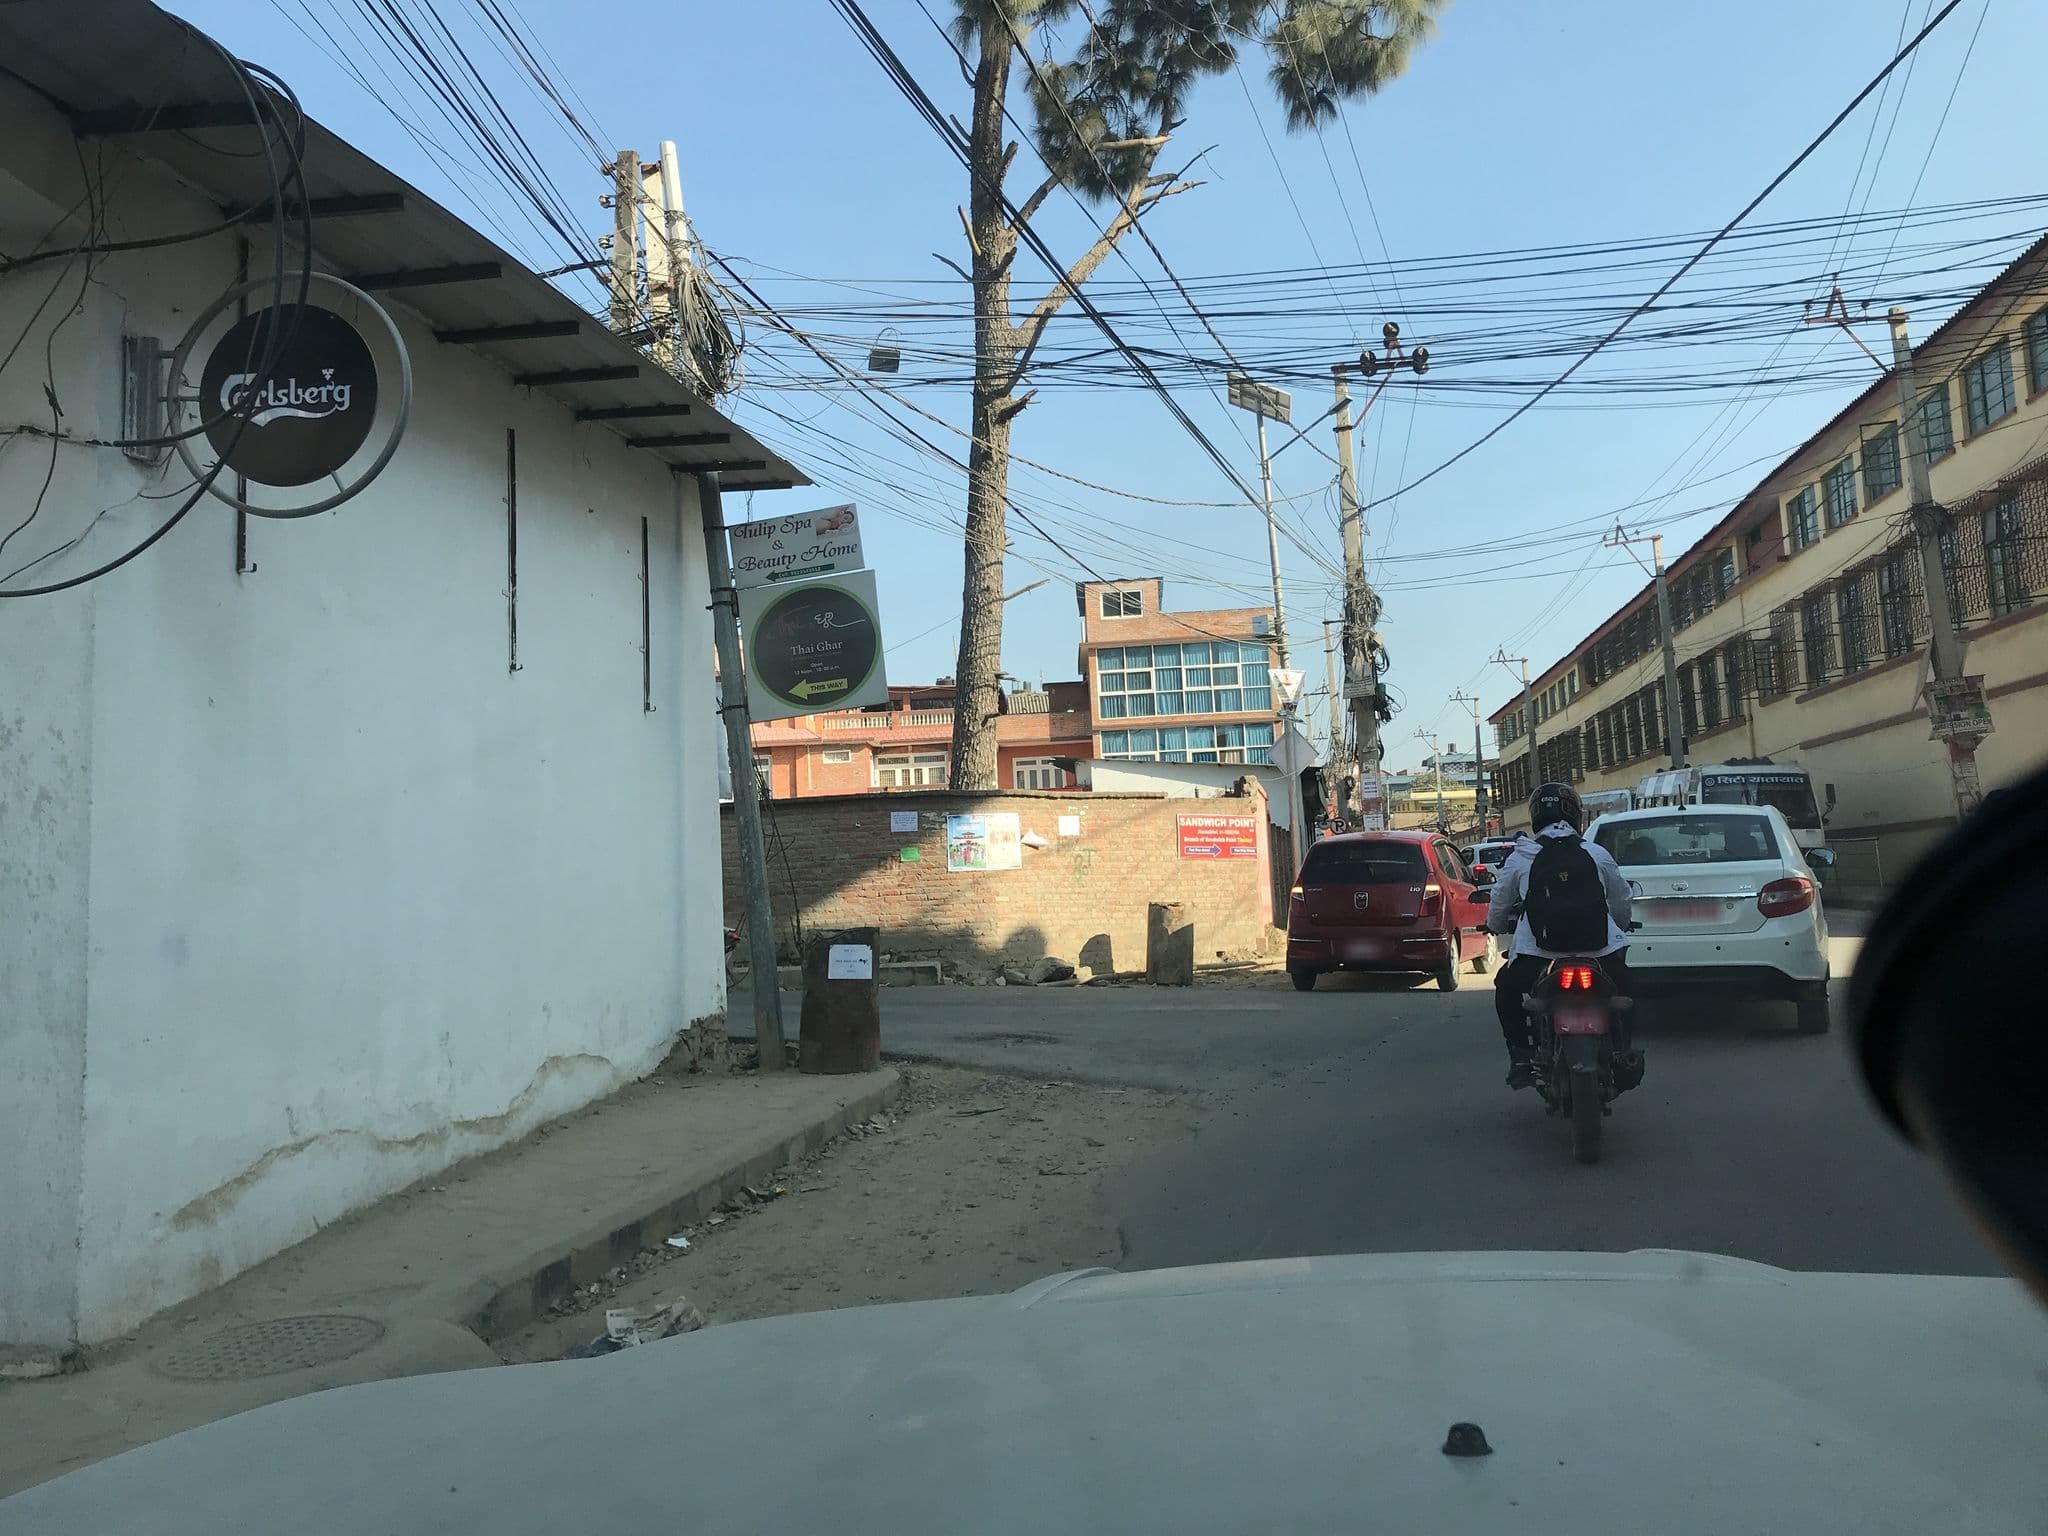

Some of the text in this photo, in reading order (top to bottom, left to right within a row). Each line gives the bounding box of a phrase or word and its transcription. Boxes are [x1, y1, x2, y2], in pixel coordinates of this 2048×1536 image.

[733, 515, 812, 539] Tulip Spa
[771, 539, 785, 551] &
[737, 541, 858, 571] Beauty Home
[791, 641, 843, 656] Thai Ghar
[827, 681, 843, 689] WAY
[1717, 775, 1804, 785] सिटी यातायात
[1179, 817, 1227, 827] SANDWICH
